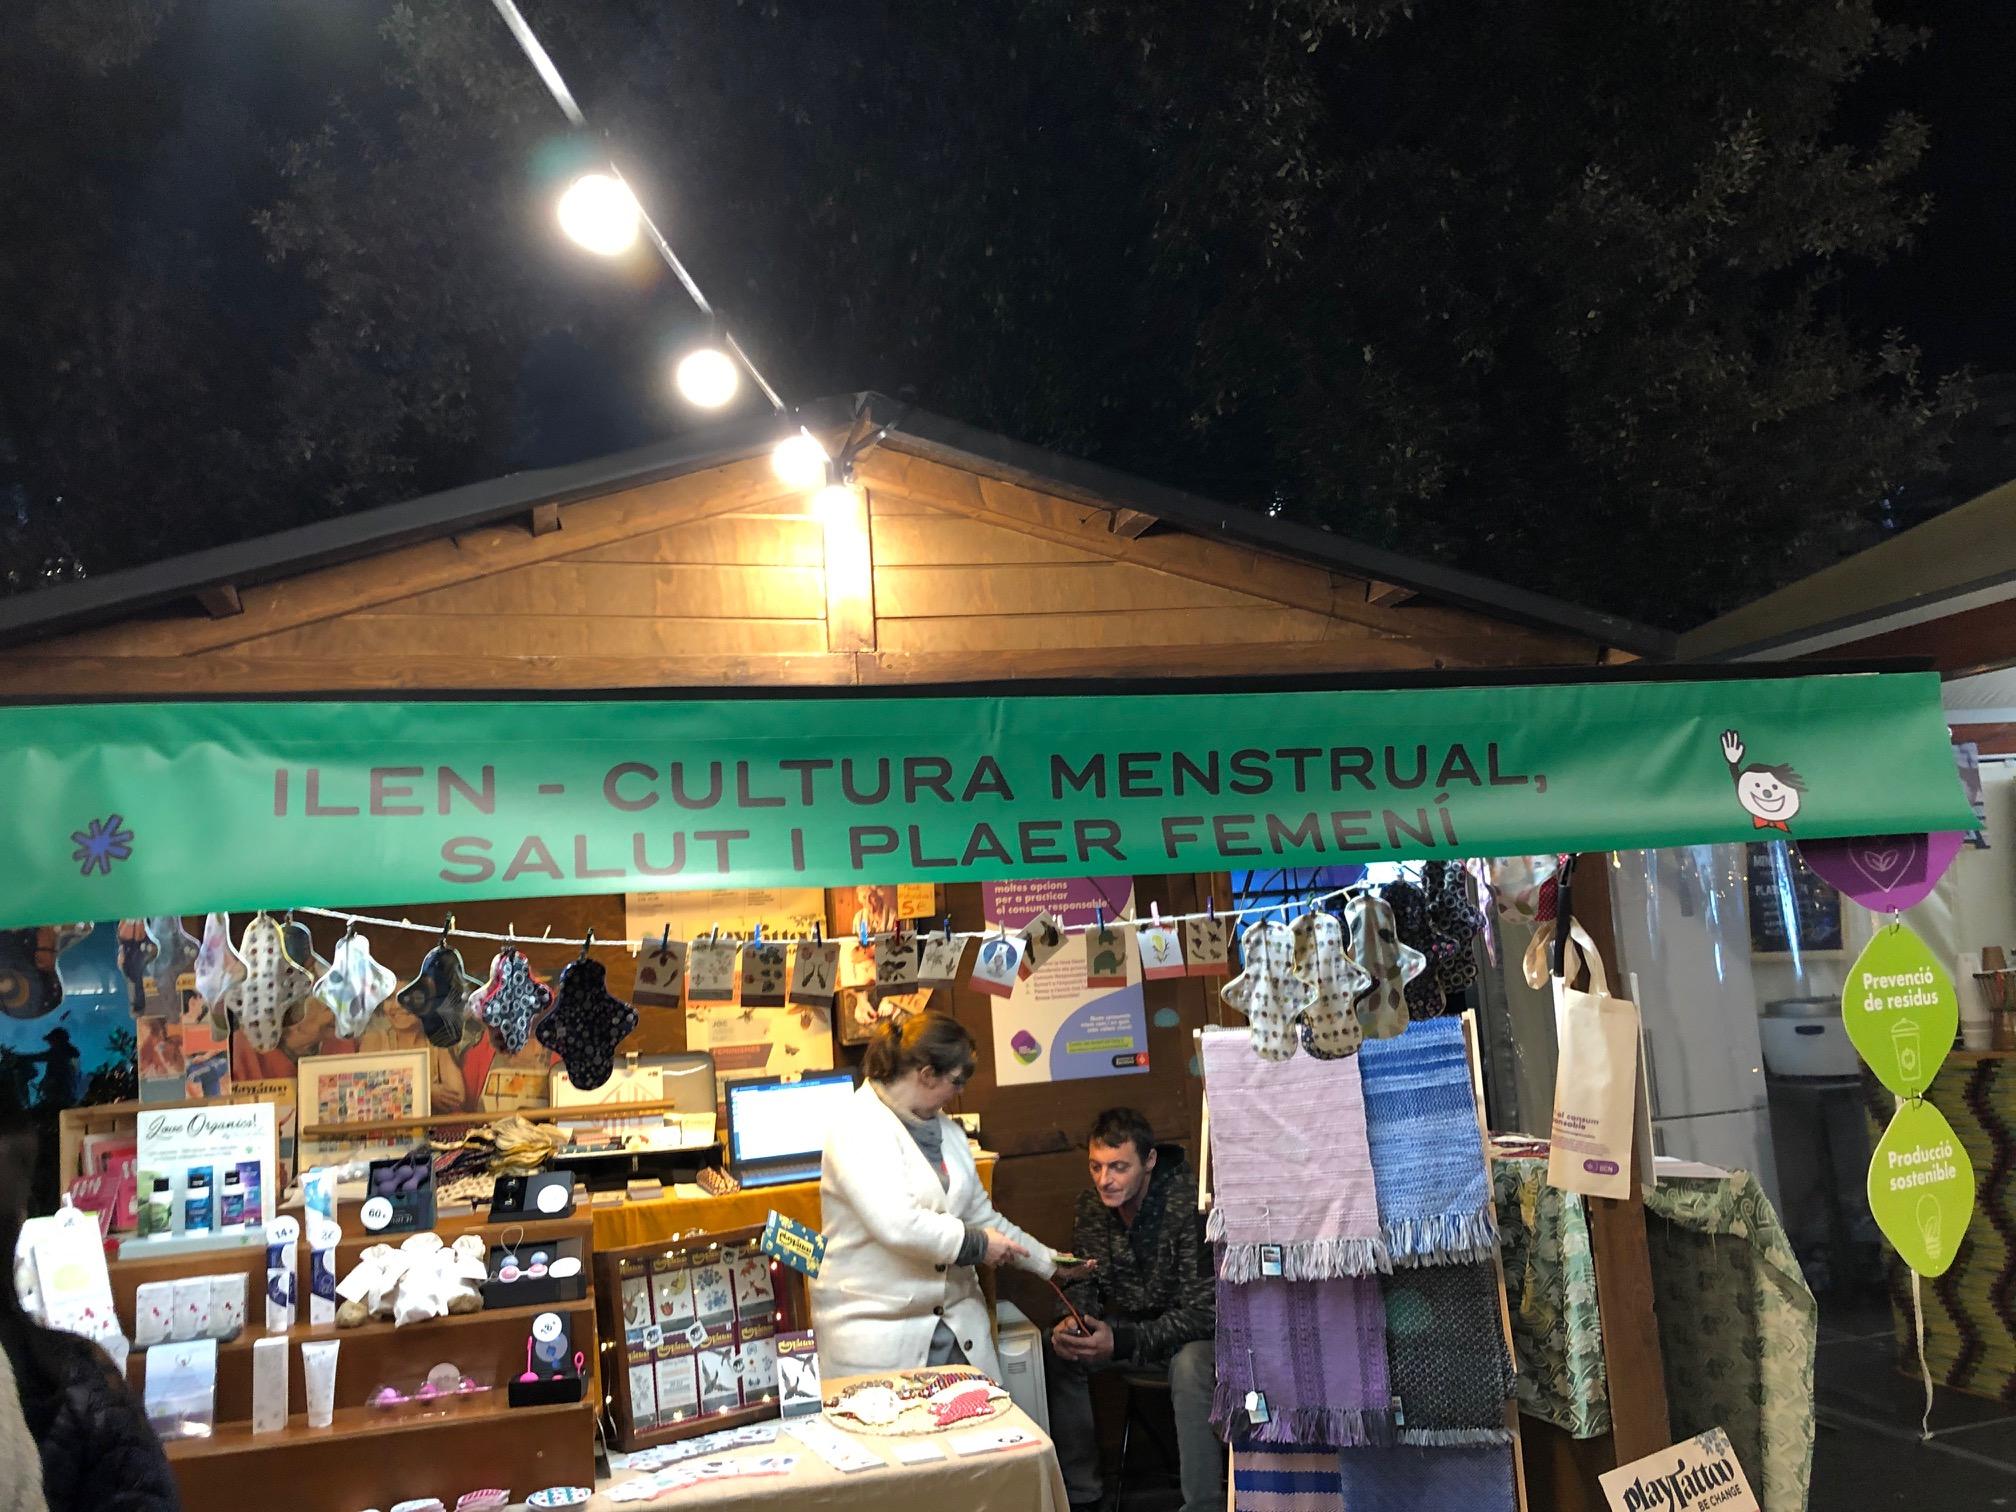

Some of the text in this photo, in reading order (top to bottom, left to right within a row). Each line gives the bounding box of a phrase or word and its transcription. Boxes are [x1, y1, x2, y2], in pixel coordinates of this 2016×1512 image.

[273, 765, 495, 816] ILEN
[602, 755, 1015, 812] CULTURA
[1050, 742, 1549, 799] MENSTRUAL,
[439, 793, 1459, 884] SALUT I PLAER FEMENÍ
[994, 883, 1027, 894] moltes
[1030, 881, 1068, 893] opcions
[995, 896, 1012, 906] per
[1025, 892, 1068, 905] practicar
[996, 906, 1006, 915] el
[1008, 904, 1046, 914] consum
[1862, 966, 1934, 990] Prevenció
[1864, 988, 1939, 1012] de residus
[1554, 1118, 1586, 1130] onsable
[1887, 1140, 1953, 1169] Producció
[1889, 1161, 1957, 1191] sostenible
[1697, 1484, 1743, 1512] BE CHANGE
